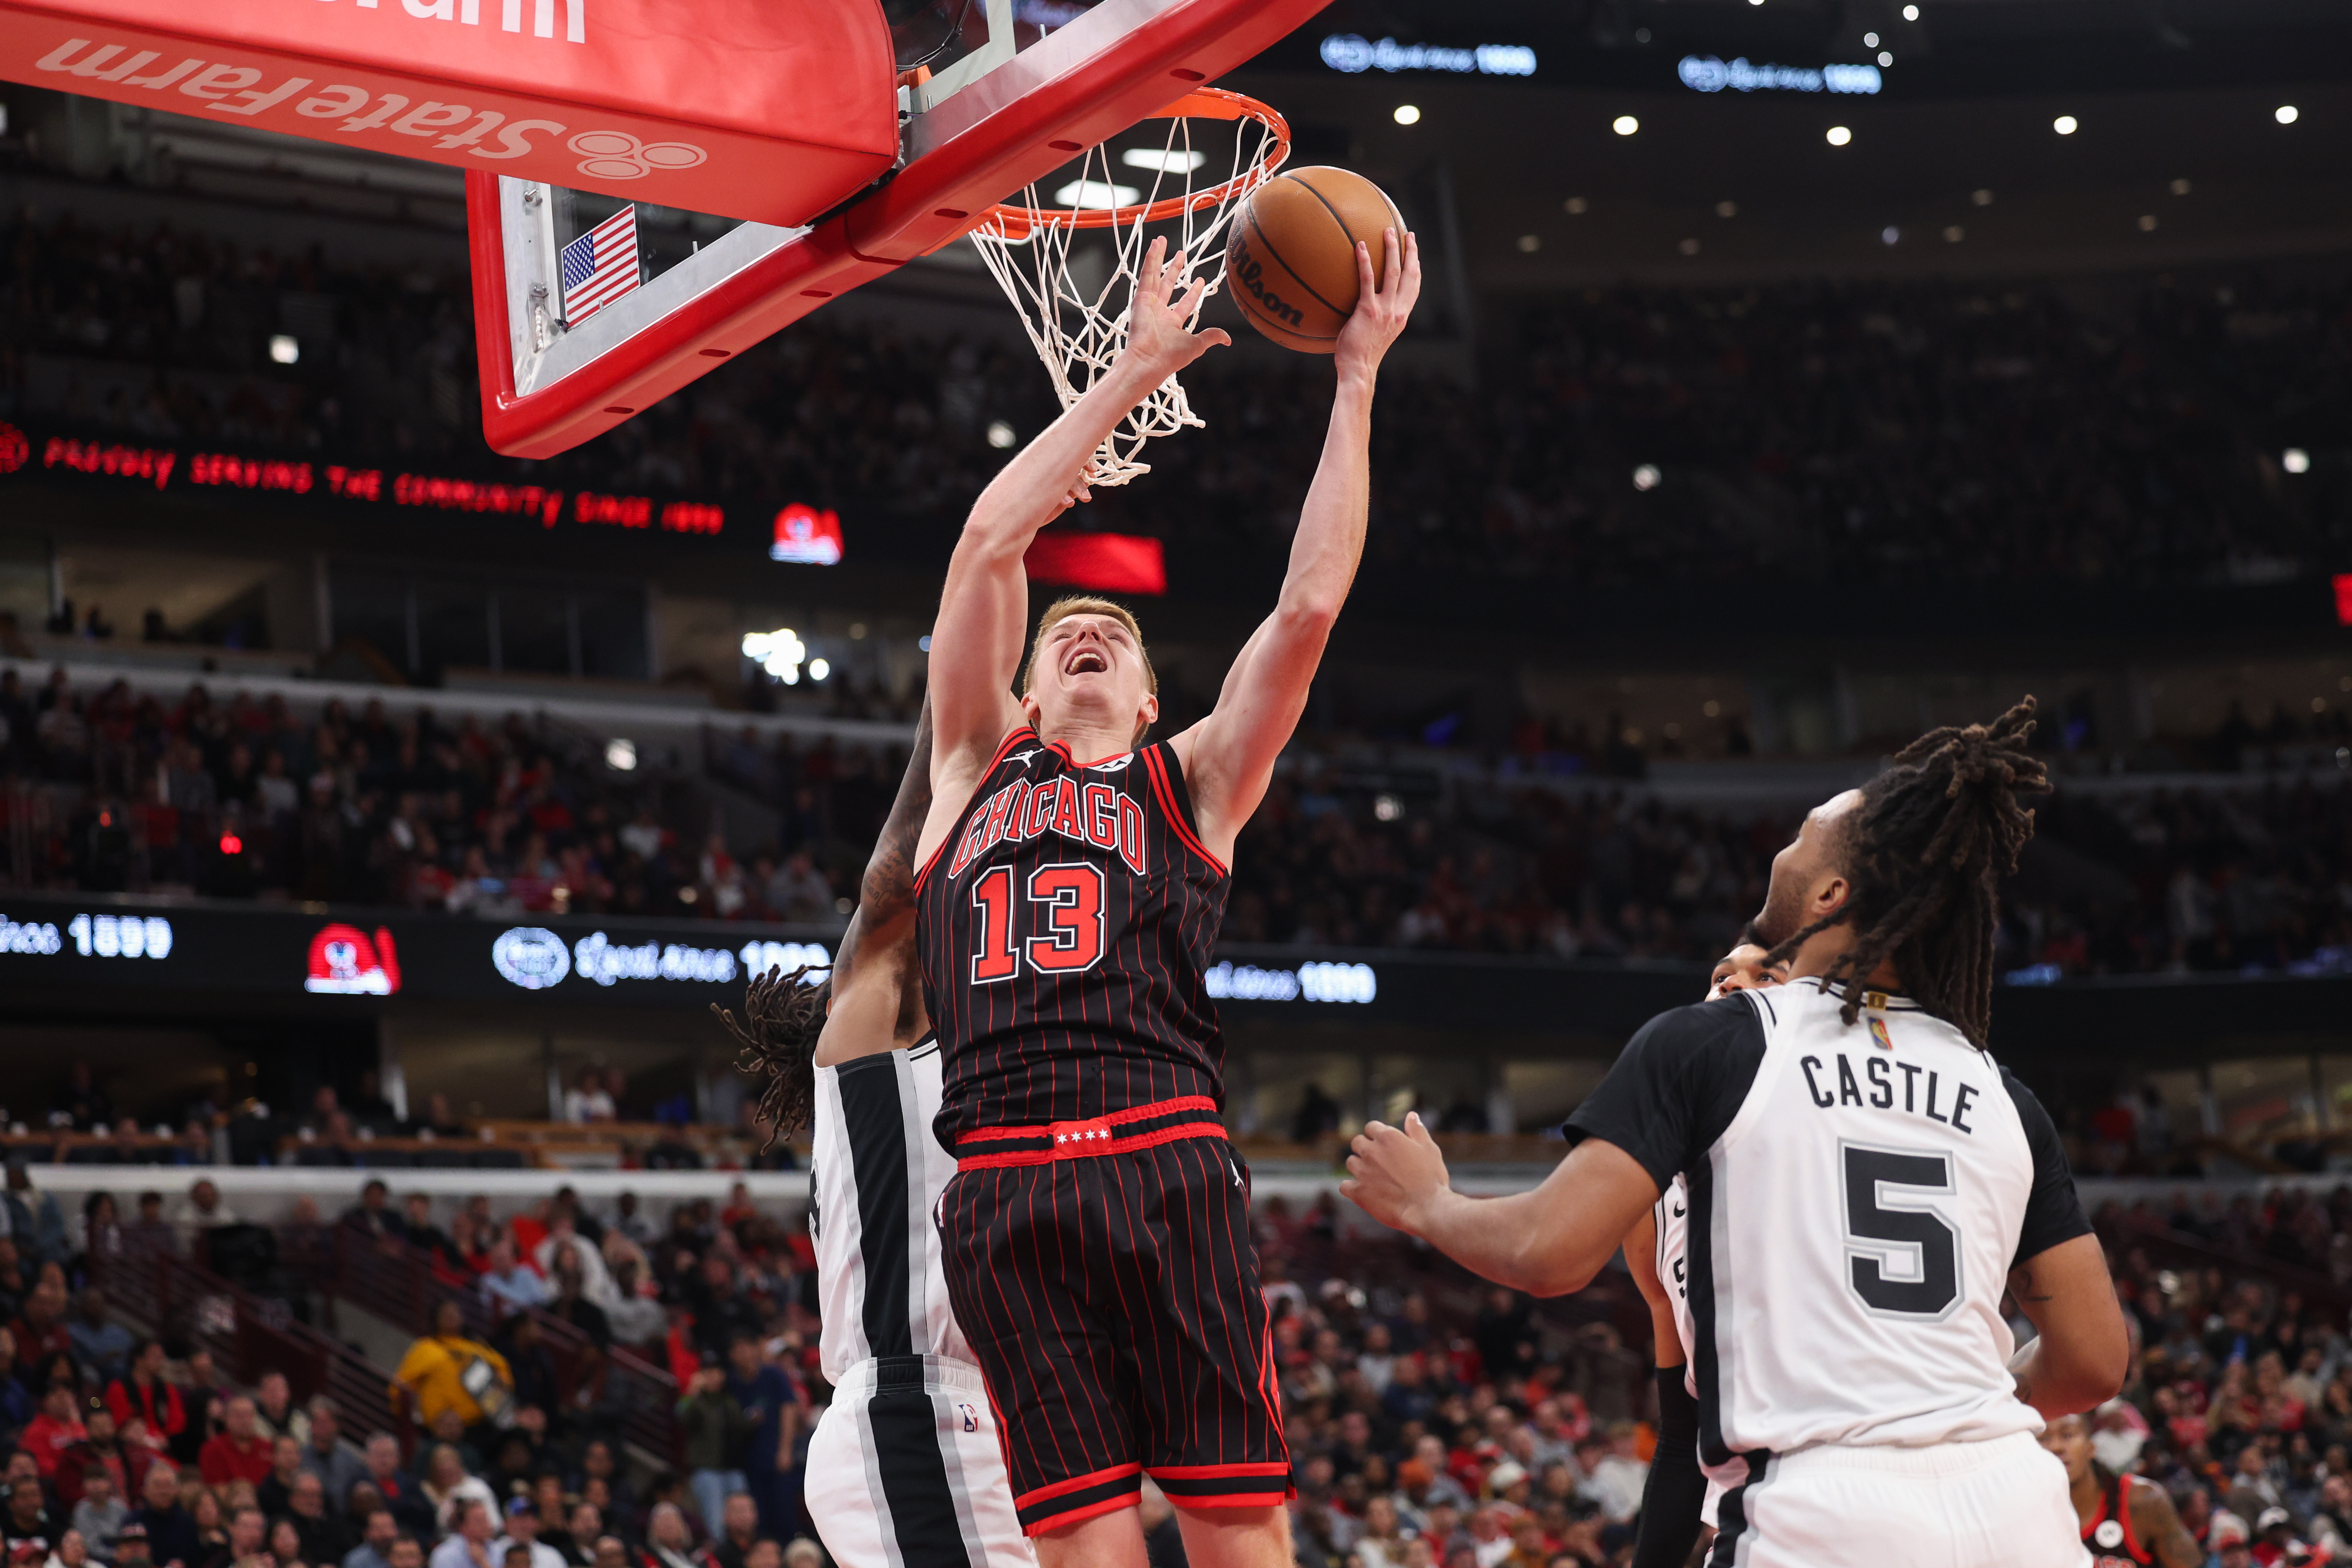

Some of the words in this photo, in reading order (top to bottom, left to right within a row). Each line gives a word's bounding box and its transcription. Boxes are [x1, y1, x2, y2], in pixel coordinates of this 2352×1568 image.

[948, 774, 1146, 879] CHICAGO
[971, 861, 1105, 985] 13
[1800, 1053, 1979, 1135] CASTLE
[1837, 1136, 1965, 1323] 5
